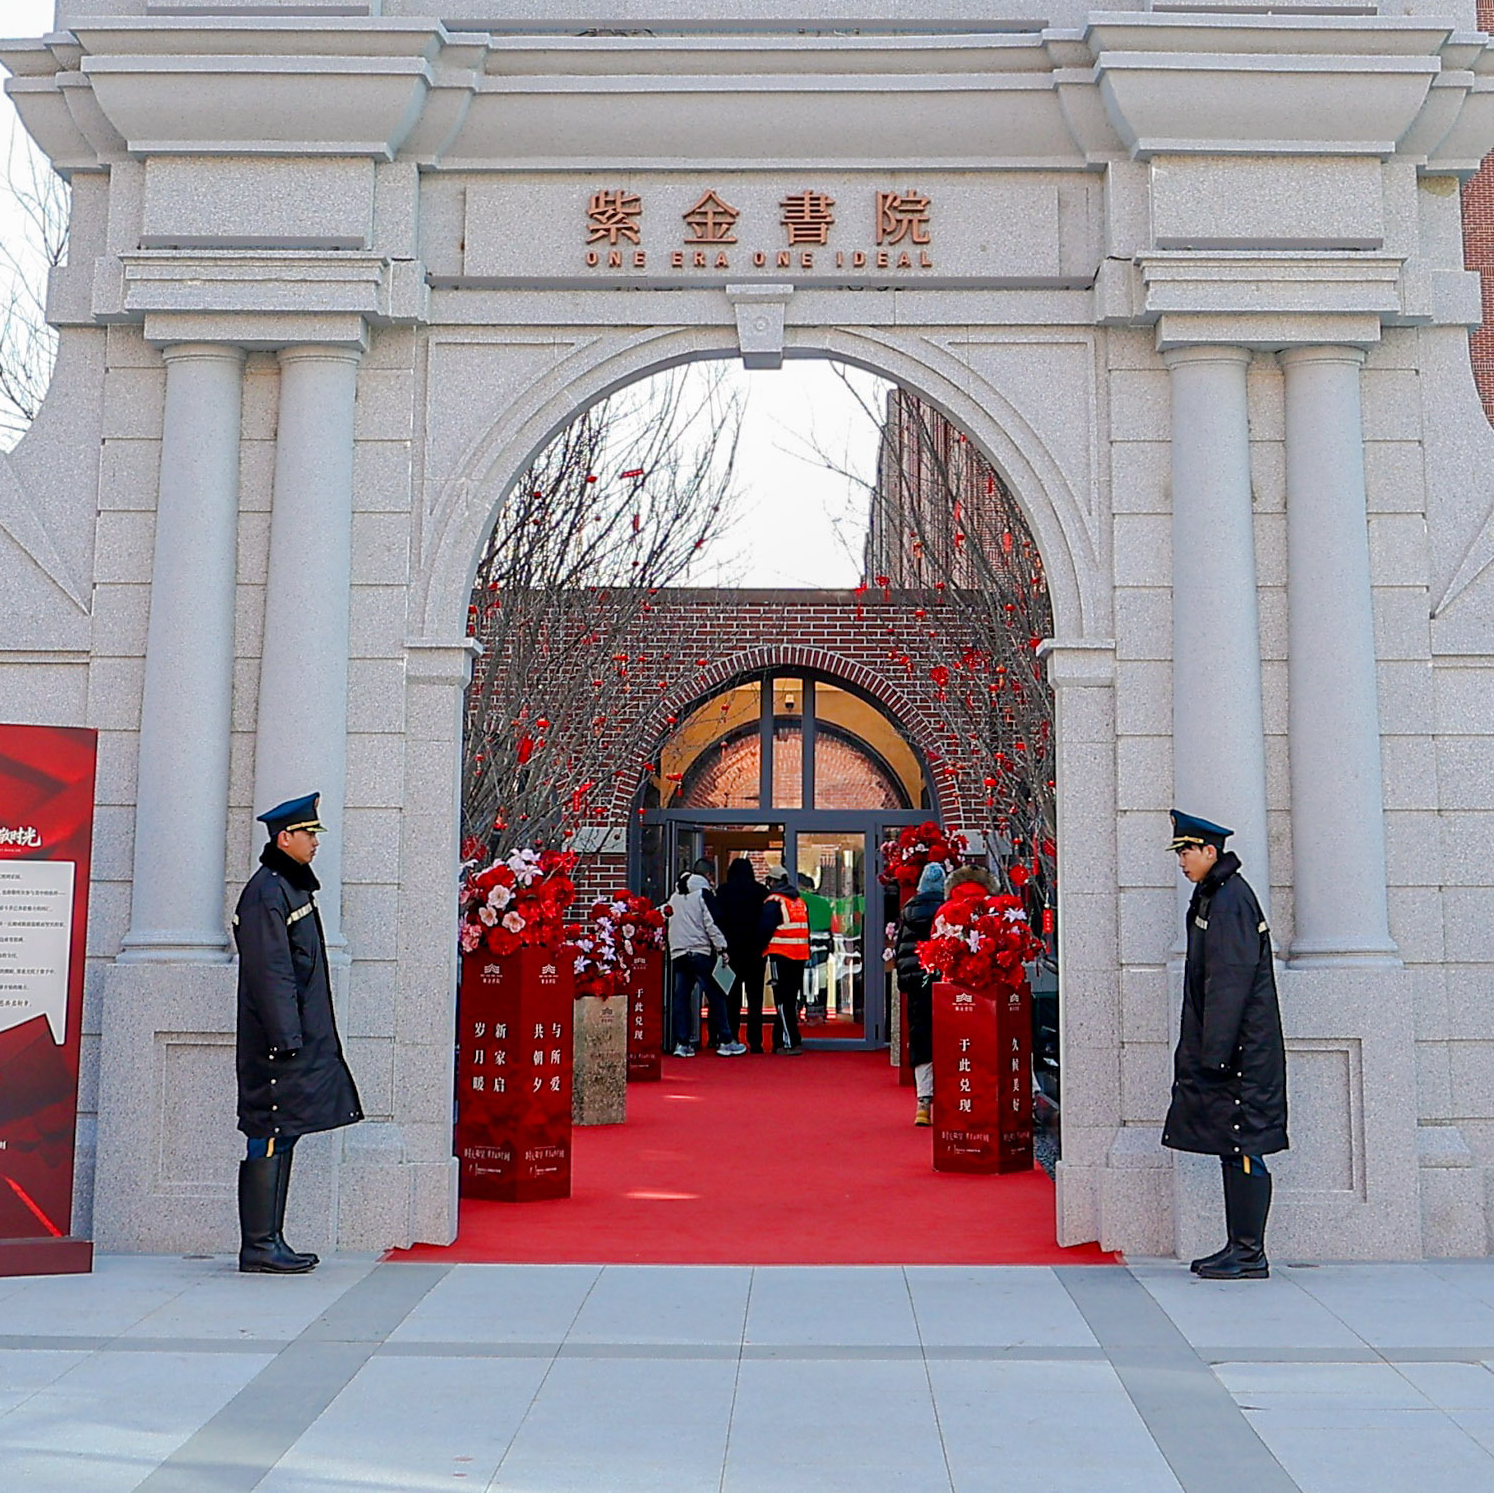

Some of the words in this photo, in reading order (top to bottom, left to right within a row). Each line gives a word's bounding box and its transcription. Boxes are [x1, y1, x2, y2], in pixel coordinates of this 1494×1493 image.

[586, 189, 931, 245] 紫金書院
[585, 251, 646, 267] ONE
[671, 251, 729, 267] ERA
[753, 251, 814, 267] ONE
[836, 251, 932, 267] IDEAL
[634, 988, 644, 1040] 于此兑现
[472, 1022, 486, 1092] 岁月暖
[493, 1023, 507, 1093] 新家启
[533, 1023, 544, 1093] 共朝夕
[550, 1022, 561, 1092] 与所爱
[959, 1038, 971, 1113] 于此兑现
